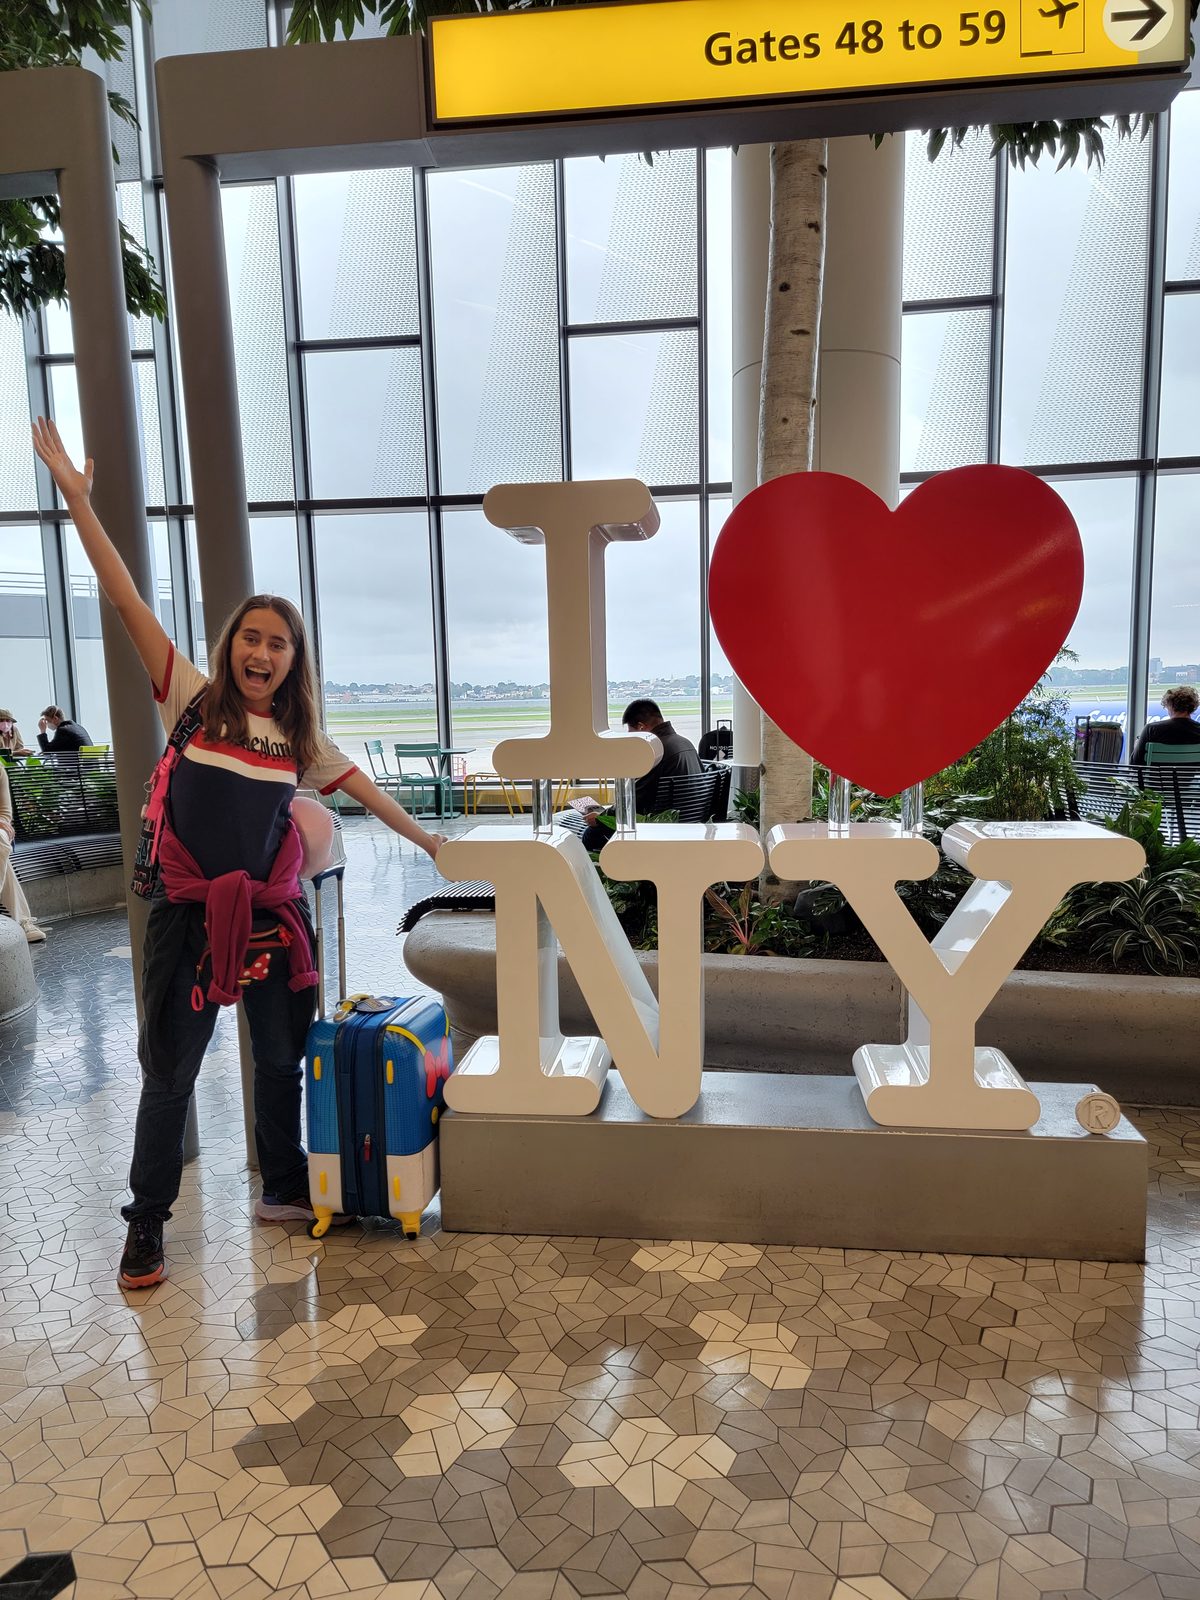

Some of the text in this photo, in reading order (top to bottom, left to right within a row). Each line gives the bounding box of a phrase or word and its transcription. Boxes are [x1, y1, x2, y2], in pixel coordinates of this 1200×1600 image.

[704, 9, 1006, 66] Gates 48 to 59
[482, 478, 661, 780] I
